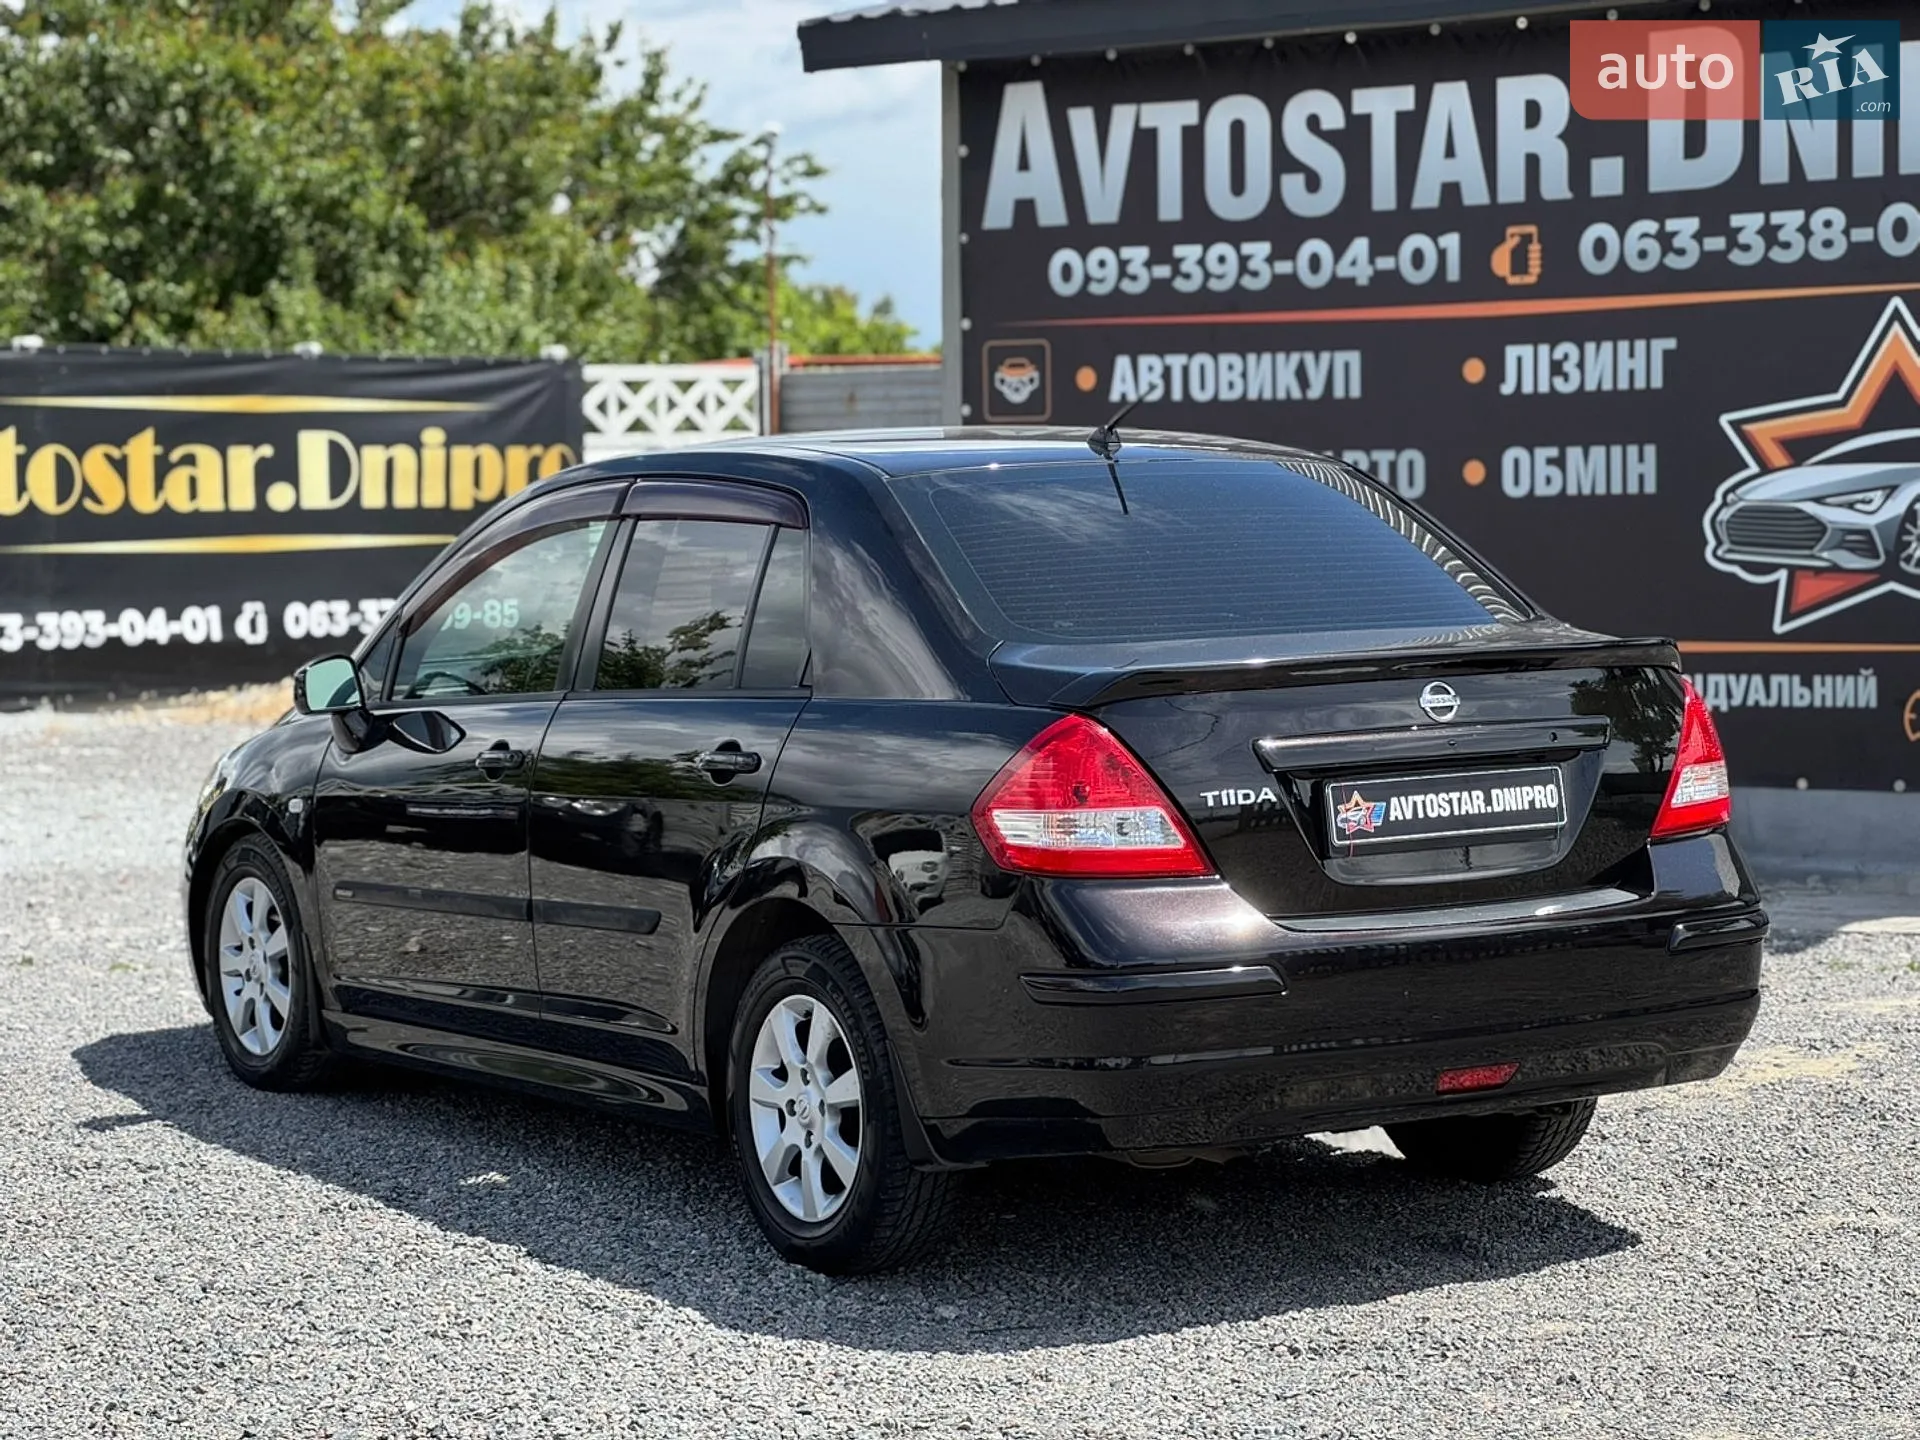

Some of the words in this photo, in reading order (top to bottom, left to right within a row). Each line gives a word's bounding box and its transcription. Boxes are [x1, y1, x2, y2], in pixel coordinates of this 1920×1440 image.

[1047, 231, 1461, 297] 093-393-04-01
[1108, 349, 1362, 402] АВТОВИКУП
[1499, 337, 1678, 395] ЛІЗИНГ
[1500, 443, 1658, 498] ОБМІН
[1685, 667, 1878, 712] ІДУАЛЬНИЙ
[1389, 783, 1558, 822] AVTOSTAR.DNIPRO
